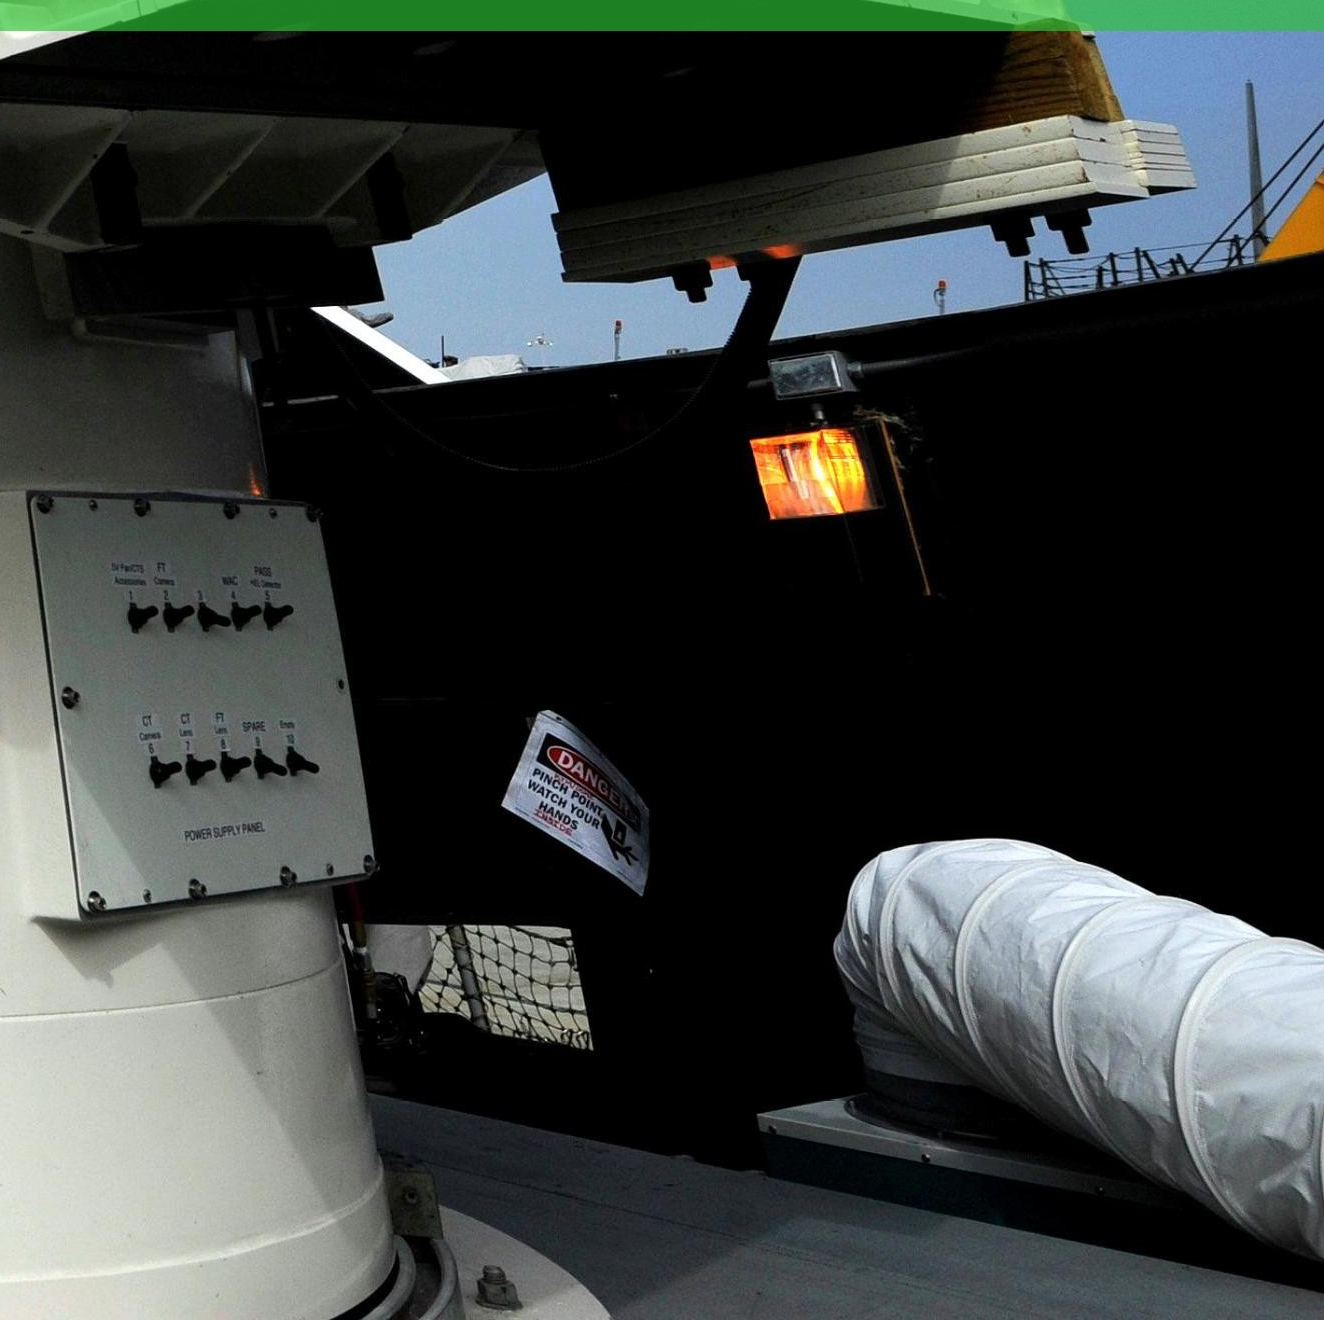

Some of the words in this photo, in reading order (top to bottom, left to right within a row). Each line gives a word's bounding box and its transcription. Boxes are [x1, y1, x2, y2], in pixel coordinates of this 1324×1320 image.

[163, 590, 169, 600] 2
[265, 590, 271, 600] 5
[142, 715, 152, 727] CT
[180, 713, 191, 724] CT
[242, 720, 266, 732] SPARE
[148, 743, 154, 754] 6
[532, 768, 568, 795] PINCH
[571, 790, 603, 816] POINT
[557, 750, 639, 823] DANGER
[527, 779, 568, 809] WATCH
[570, 804, 601, 830] YOUR
[539, 801, 578, 831] HANDS
[184, 827, 212, 841] POWER
[213, 824, 241, 838] SUPPLY
[242, 822, 265, 834] PANEL
